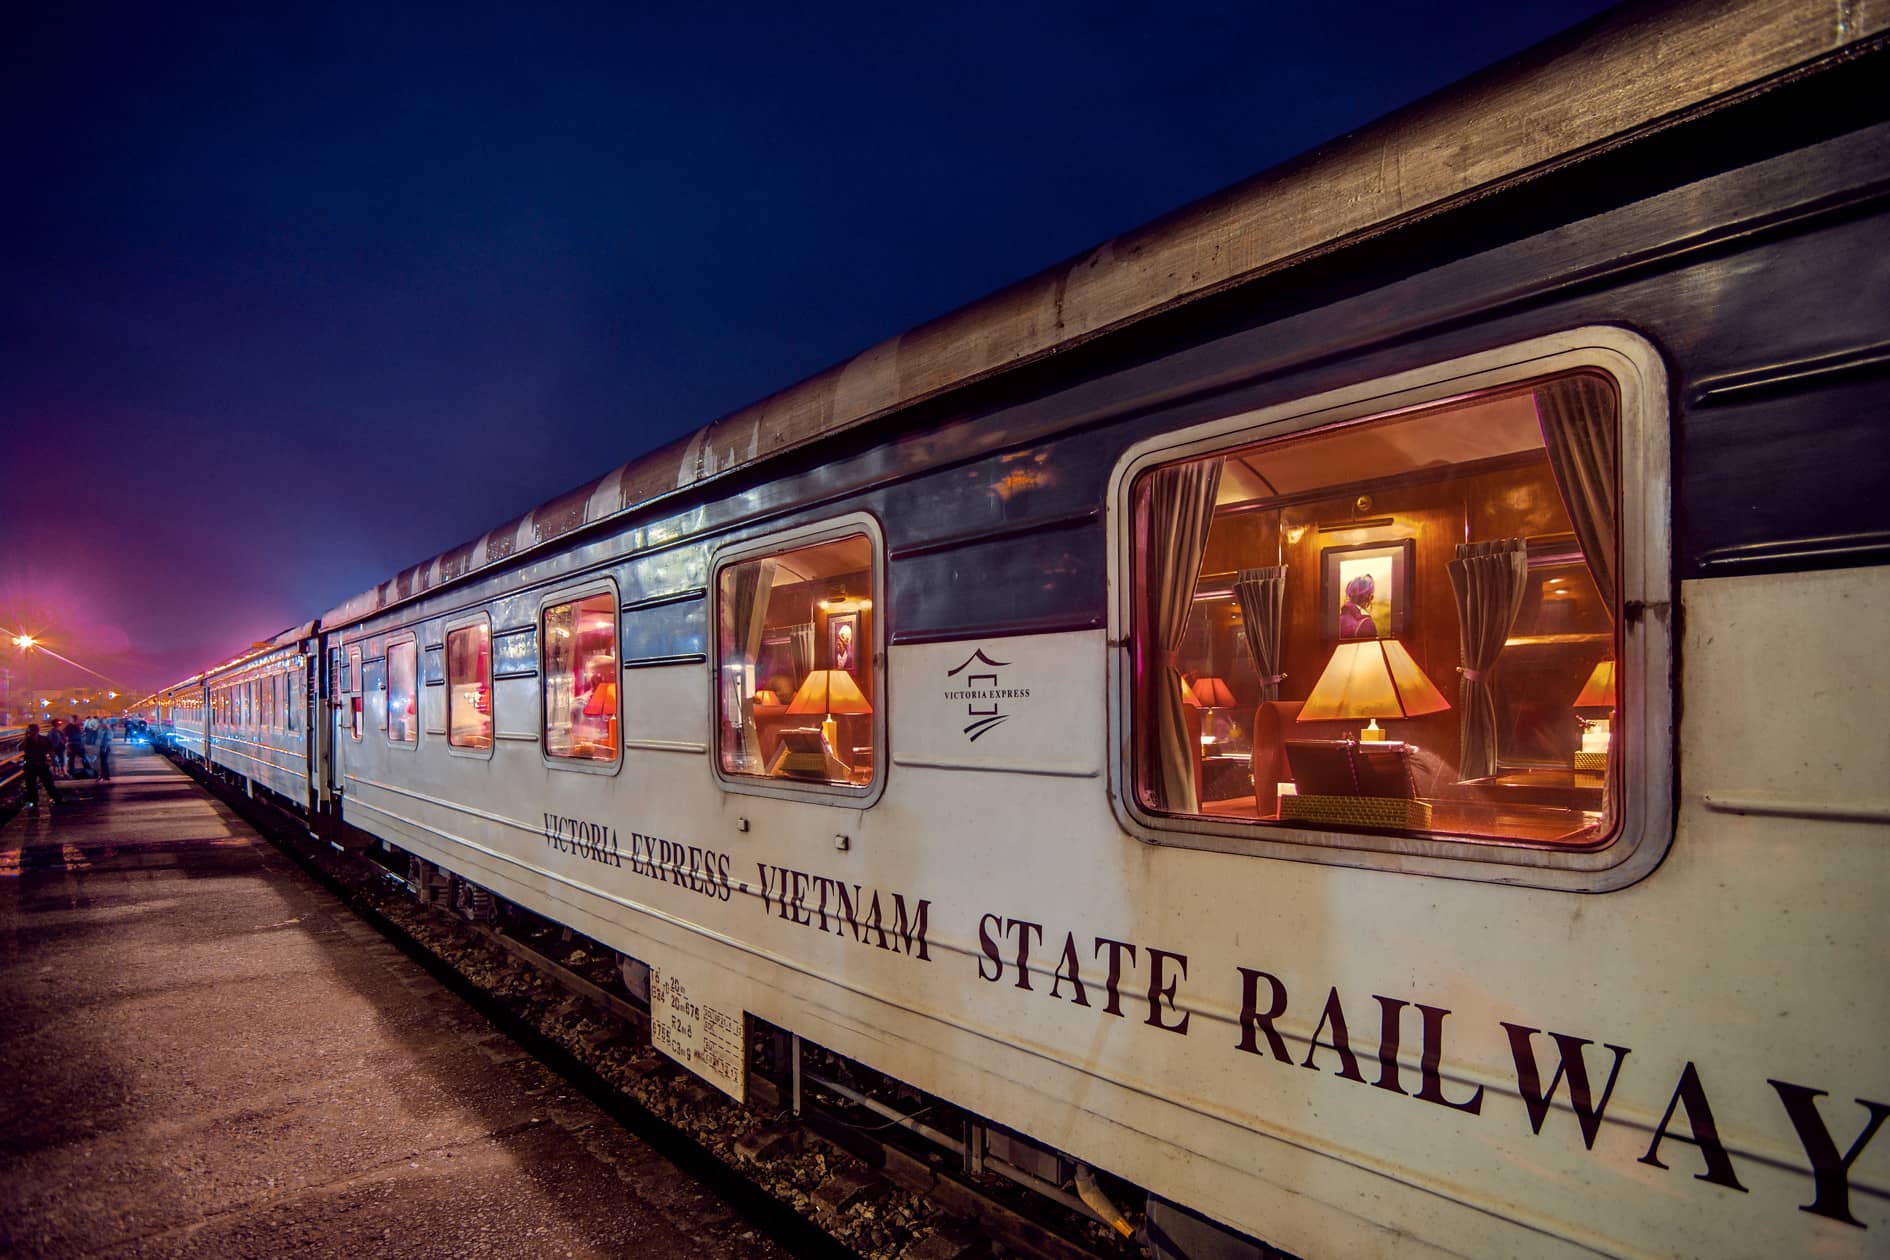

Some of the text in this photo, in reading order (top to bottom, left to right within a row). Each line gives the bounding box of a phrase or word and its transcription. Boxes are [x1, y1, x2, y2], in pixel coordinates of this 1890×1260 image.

[944, 689, 1031, 700] VICTORIA EXPRESS
[543, 812, 622, 868] VICTORIA
[631, 832, 731, 901] EXPRESS
[757, 862, 932, 962] VIETNAM
[978, 912, 1190, 1036] STATE
[1235, 966, 1890, 1230] RAILWAY
